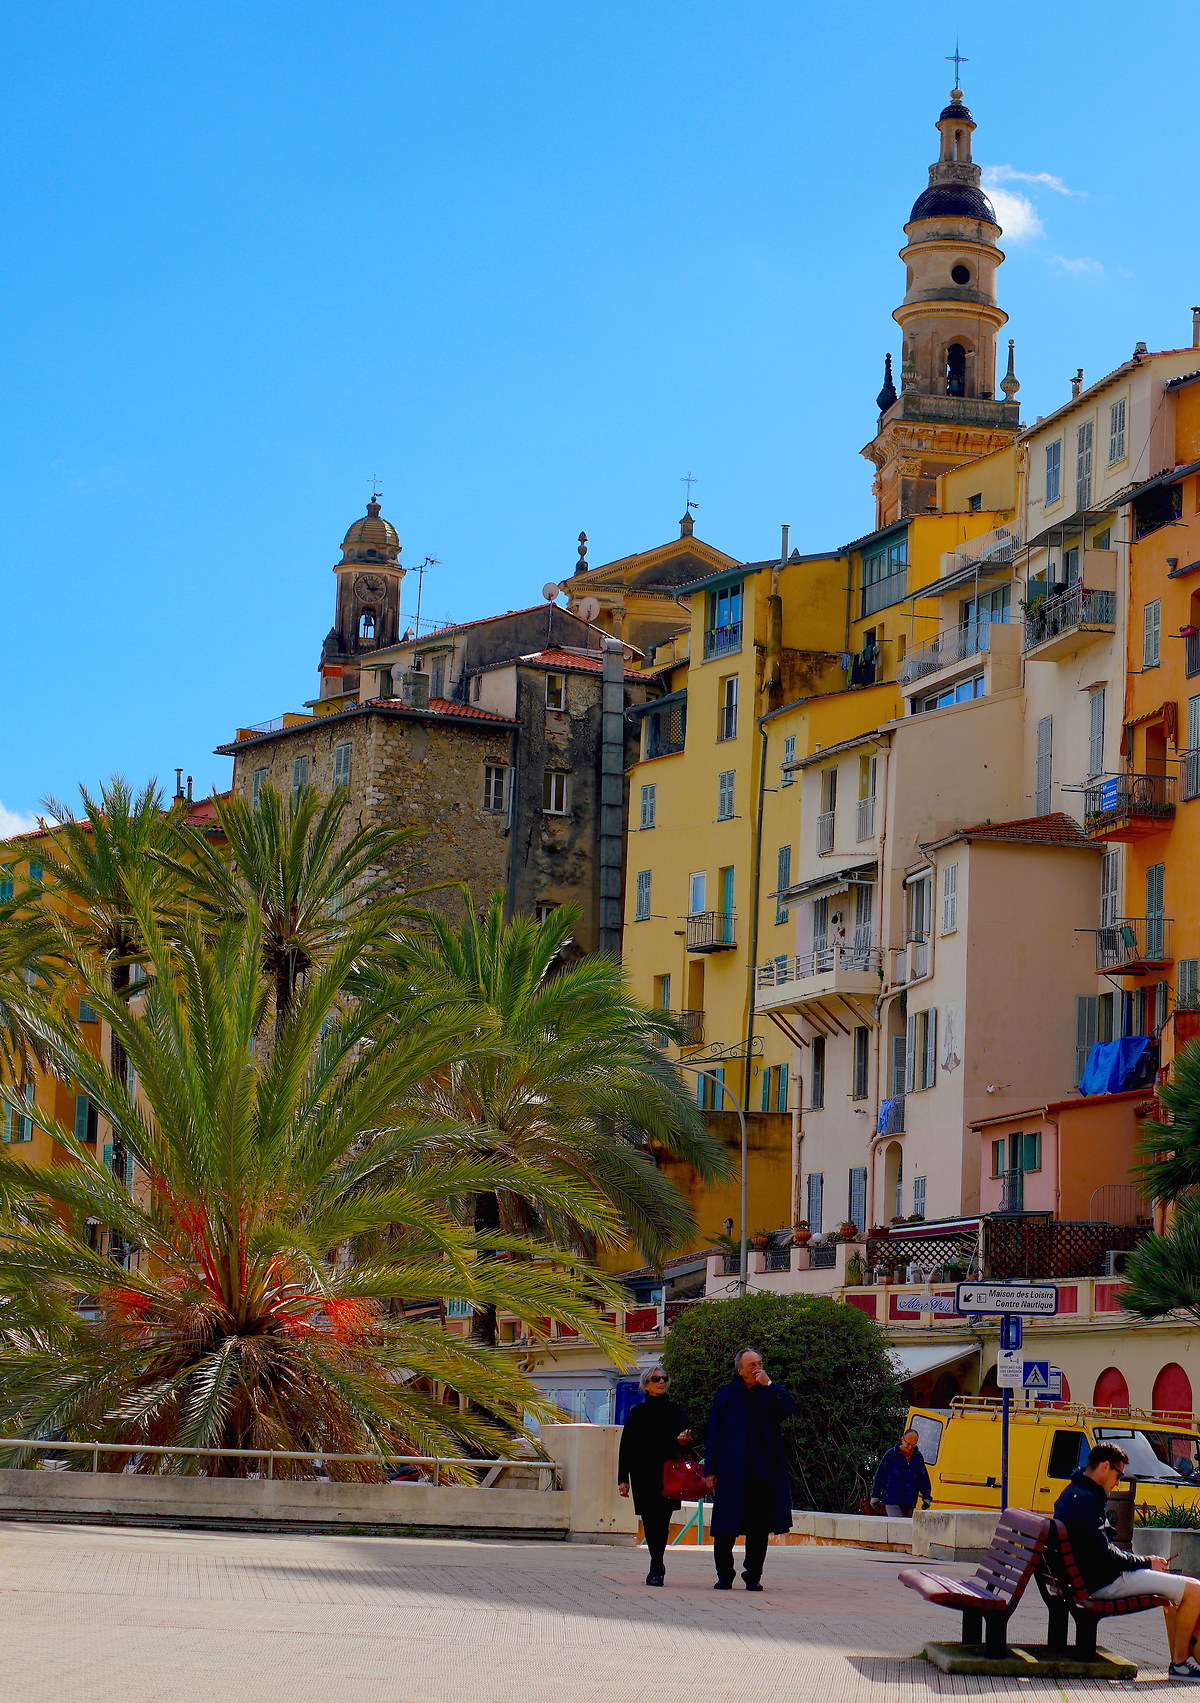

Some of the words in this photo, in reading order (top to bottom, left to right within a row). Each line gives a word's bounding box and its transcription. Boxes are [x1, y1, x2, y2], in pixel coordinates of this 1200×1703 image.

[988, 1290, 1015, 1298] Maison
[1016, 1290, 1029, 1298] des
[1030, 1291, 1054, 1299] Loisirs
[995, 1300, 1020, 1308] Centre
[1020, 1300, 1054, 1310] Nautique
